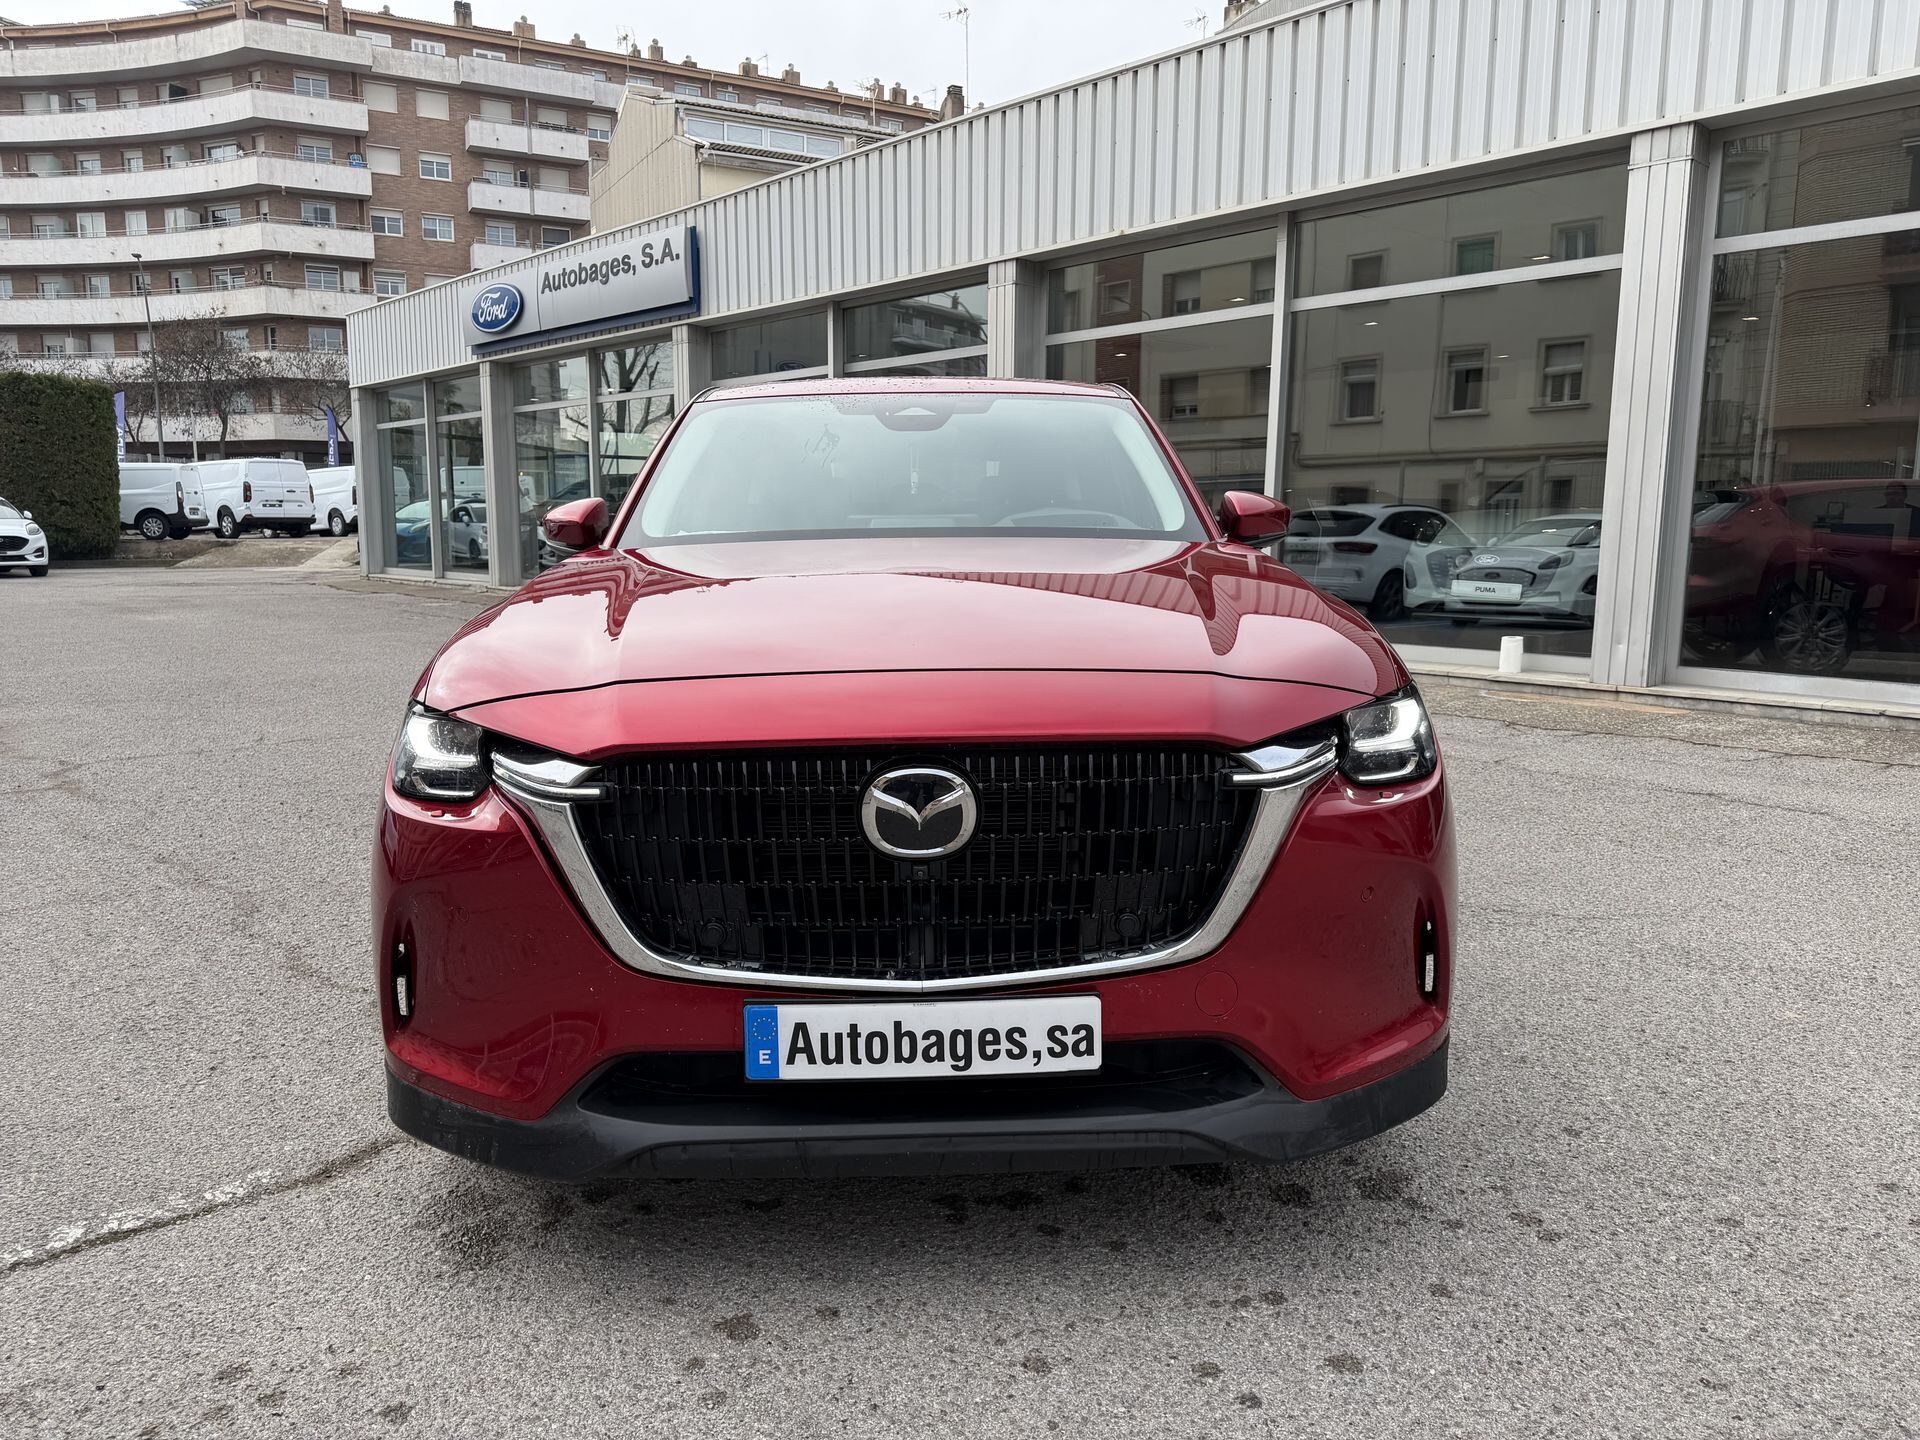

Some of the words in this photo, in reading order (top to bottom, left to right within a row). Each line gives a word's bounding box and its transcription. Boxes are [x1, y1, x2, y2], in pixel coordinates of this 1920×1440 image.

[541, 253, 636, 294] Autobages,
[641, 237, 680, 269] S.A.
[478, 291, 509, 324] Ford
[1474, 586, 1496, 594] PUMA
[758, 1049, 771, 1065] E
[785, 1020, 1095, 1072] Autobages,sa
